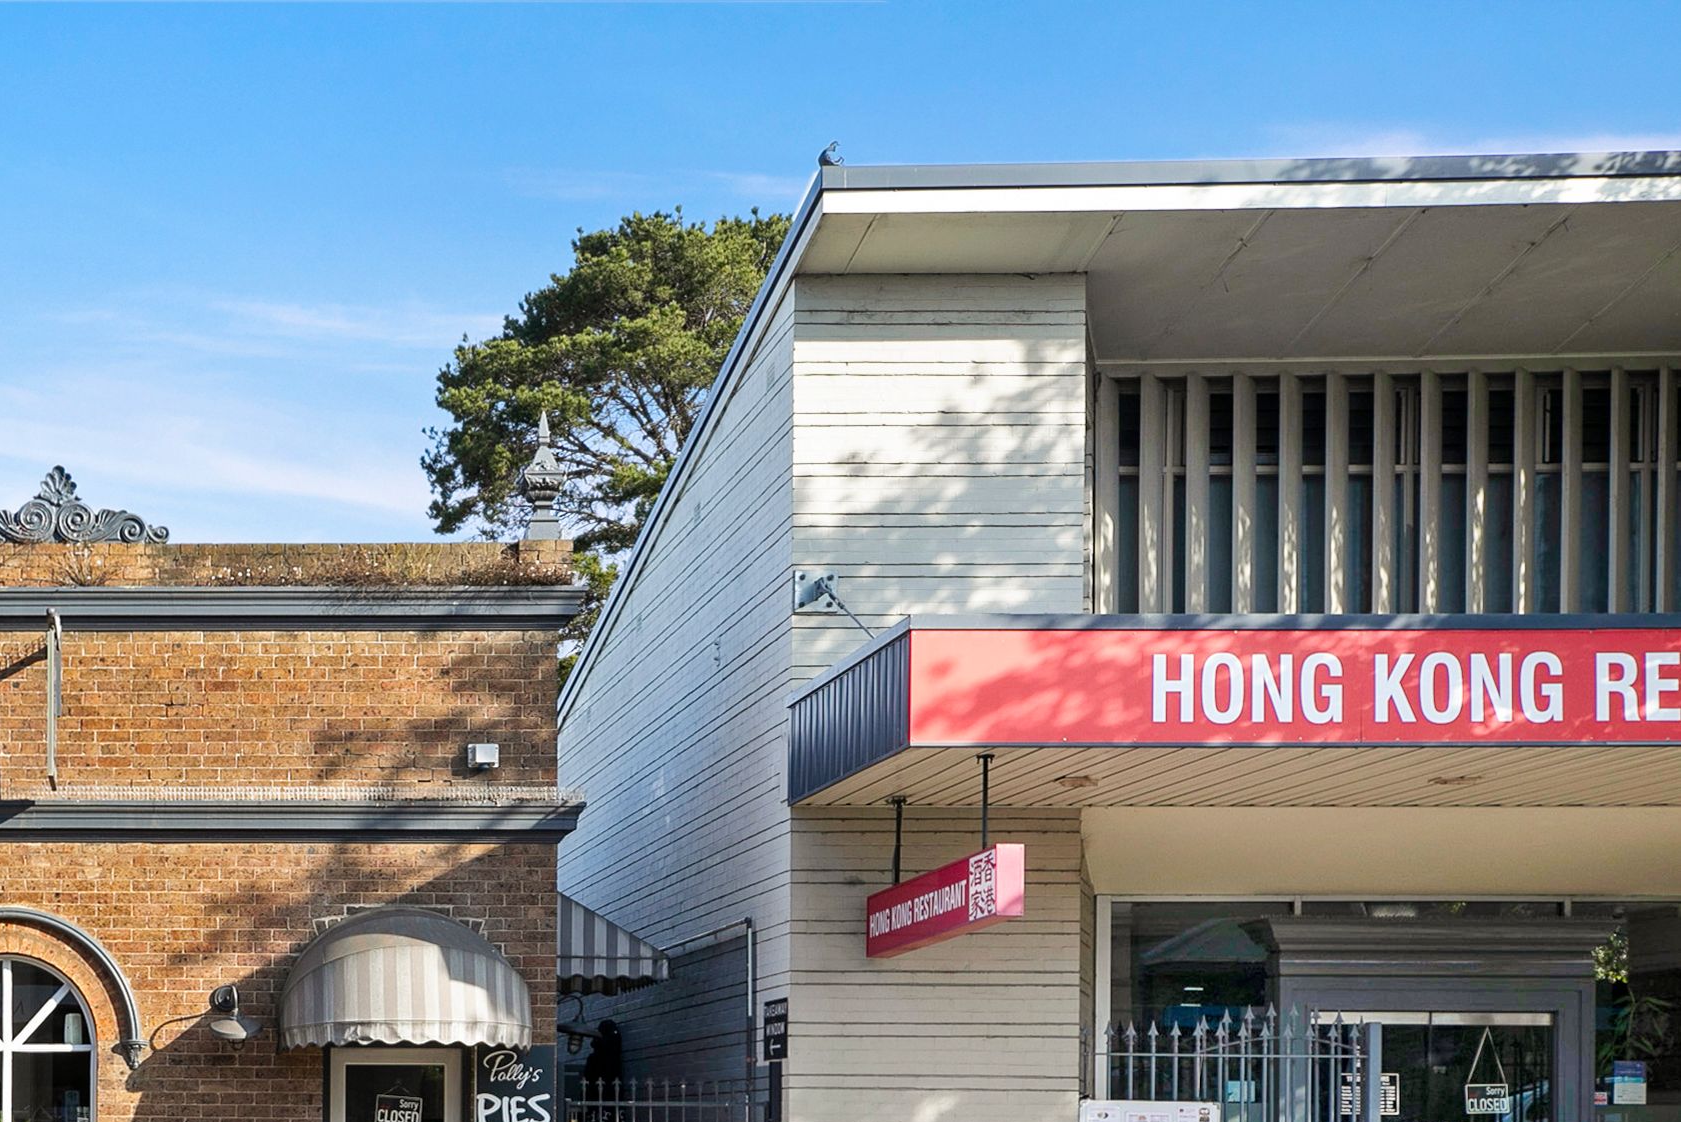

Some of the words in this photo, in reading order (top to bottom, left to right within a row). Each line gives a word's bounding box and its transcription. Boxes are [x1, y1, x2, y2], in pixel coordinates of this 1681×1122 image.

[1152, 652, 1343, 725] HONG
[1374, 652, 1564, 725] KONG
[1595, 652, 1681, 721] RE
[869, 908, 890, 938] HONG
[891, 899, 913, 931] KONG
[913, 879, 968, 924] RESTAURANT
[483, 1050, 544, 1090] Polly's
[398, 1098, 419, 1111] Sorry
[1468, 1097, 1508, 1113] CLOSED
[1485, 1085, 1506, 1098] Sorry
